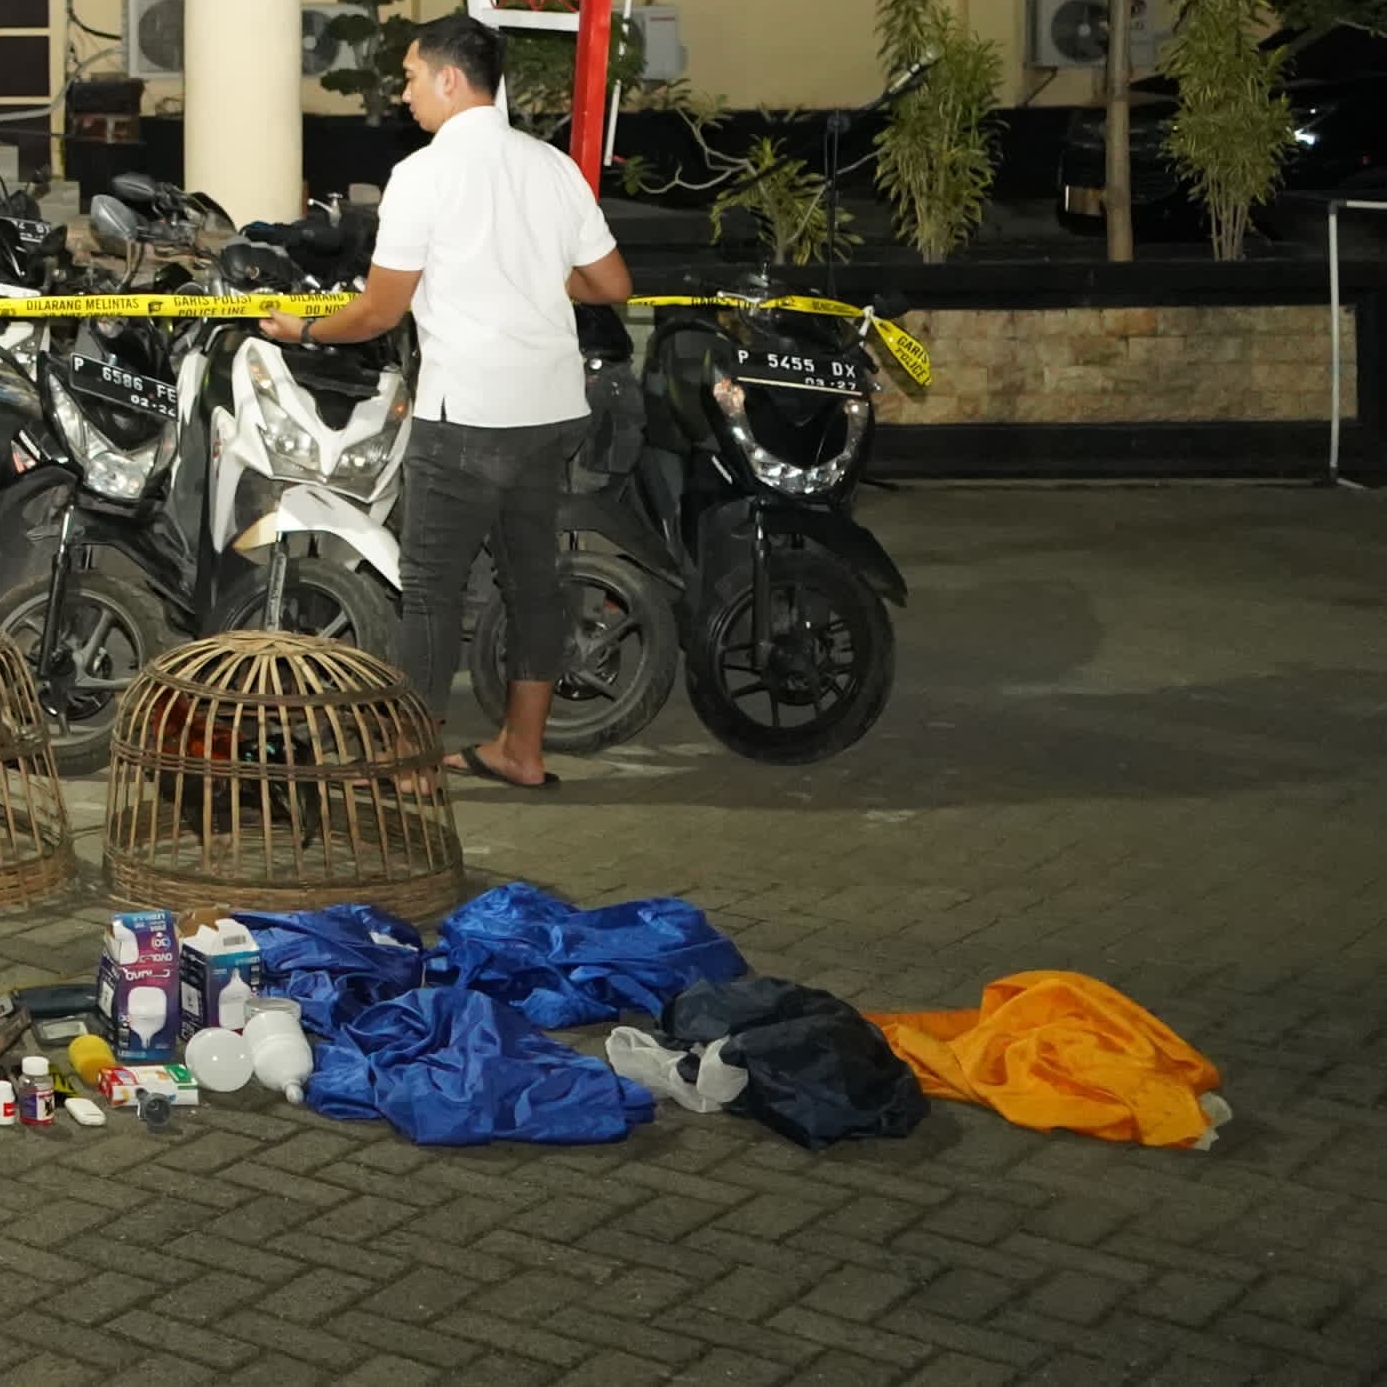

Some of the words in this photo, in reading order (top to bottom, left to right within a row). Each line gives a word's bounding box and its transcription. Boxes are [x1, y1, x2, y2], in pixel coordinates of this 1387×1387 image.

[26, 299, 82, 311] DILARANG
[85, 297, 140, 310] MELINTAS
[220, 306, 246, 315] LINE
[305, 304, 321, 315] DO
[738, 350, 749, 364] P
[767, 353, 815, 373] 5455
[831, 361, 857, 379] DX
[74, 357, 84, 372] P
[102, 367, 144, 391] 6586
